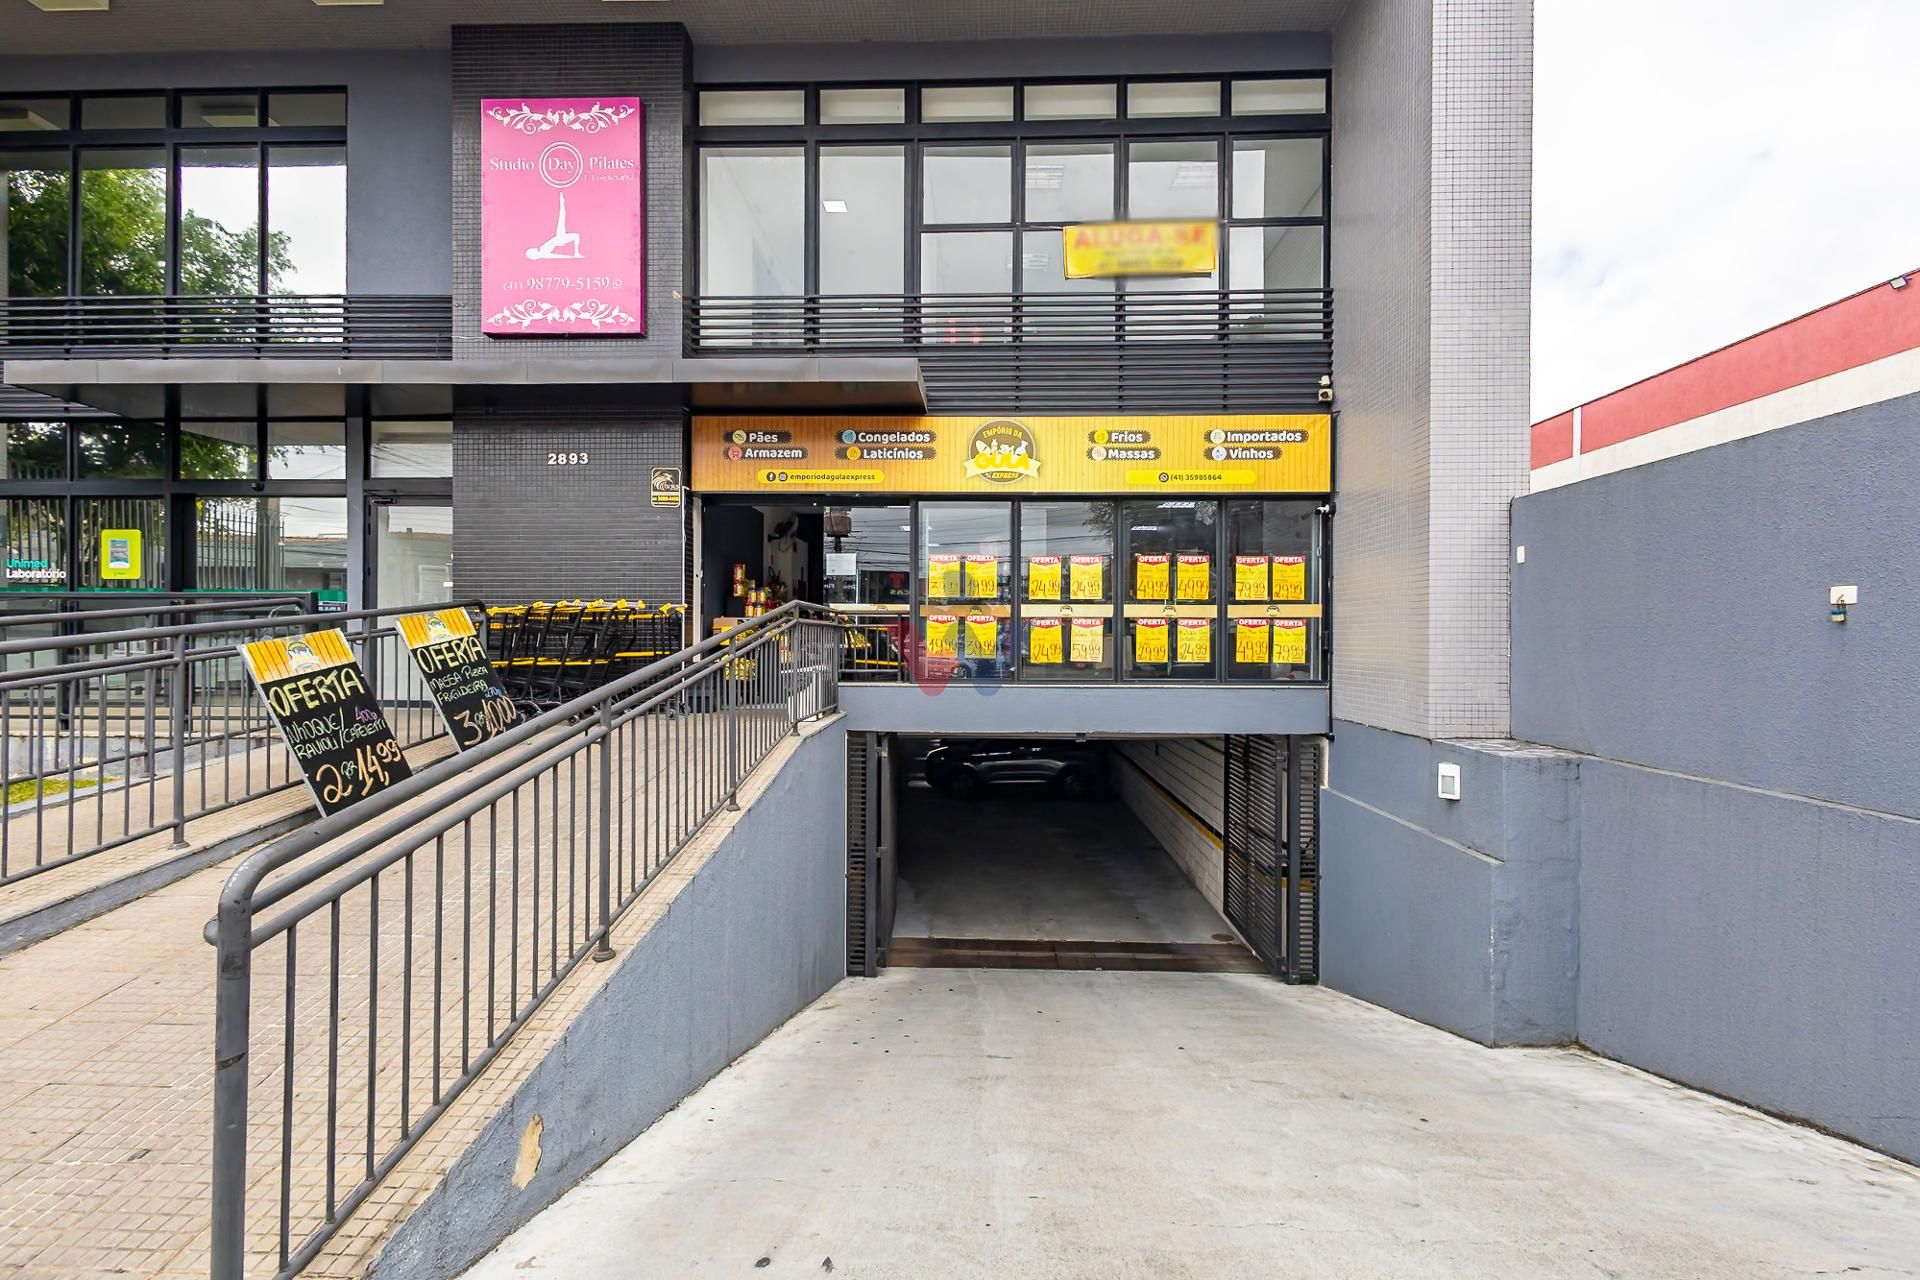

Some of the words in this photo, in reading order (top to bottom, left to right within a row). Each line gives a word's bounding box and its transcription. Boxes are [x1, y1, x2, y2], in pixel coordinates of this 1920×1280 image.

[489, 156, 535, 171] Studio
[548, 157, 576, 174] Day
[589, 155, 634, 170] Pilates
[526, 277, 610, 291] 98779-5159
[749, 431, 778, 443] Pães
[858, 431, 930, 444] Congelados
[982, 426, 1012, 439] EMPÓRIO
[1111, 431, 1143, 443] Frios
[1227, 431, 1302, 444] Importados
[547, 453, 589, 465] 2893
[745, 447, 803, 459] Armazem
[863, 448, 924, 460] Laticínios
[1108, 449, 1155, 459] Massas
[1229, 448, 1274, 459] Vinhos
[790, 472, 876, 482] emporiodagulaexpress
[6, 559, 49, 568] Unimed
[6, 568, 66, 578] Laboratório
[416, 635, 487, 674] OFERTA
[429, 671, 463, 691] MASSA
[268, 667, 366, 718] OFERTA
[453, 709, 482, 746] 3
[315, 763, 353, 804] 2
